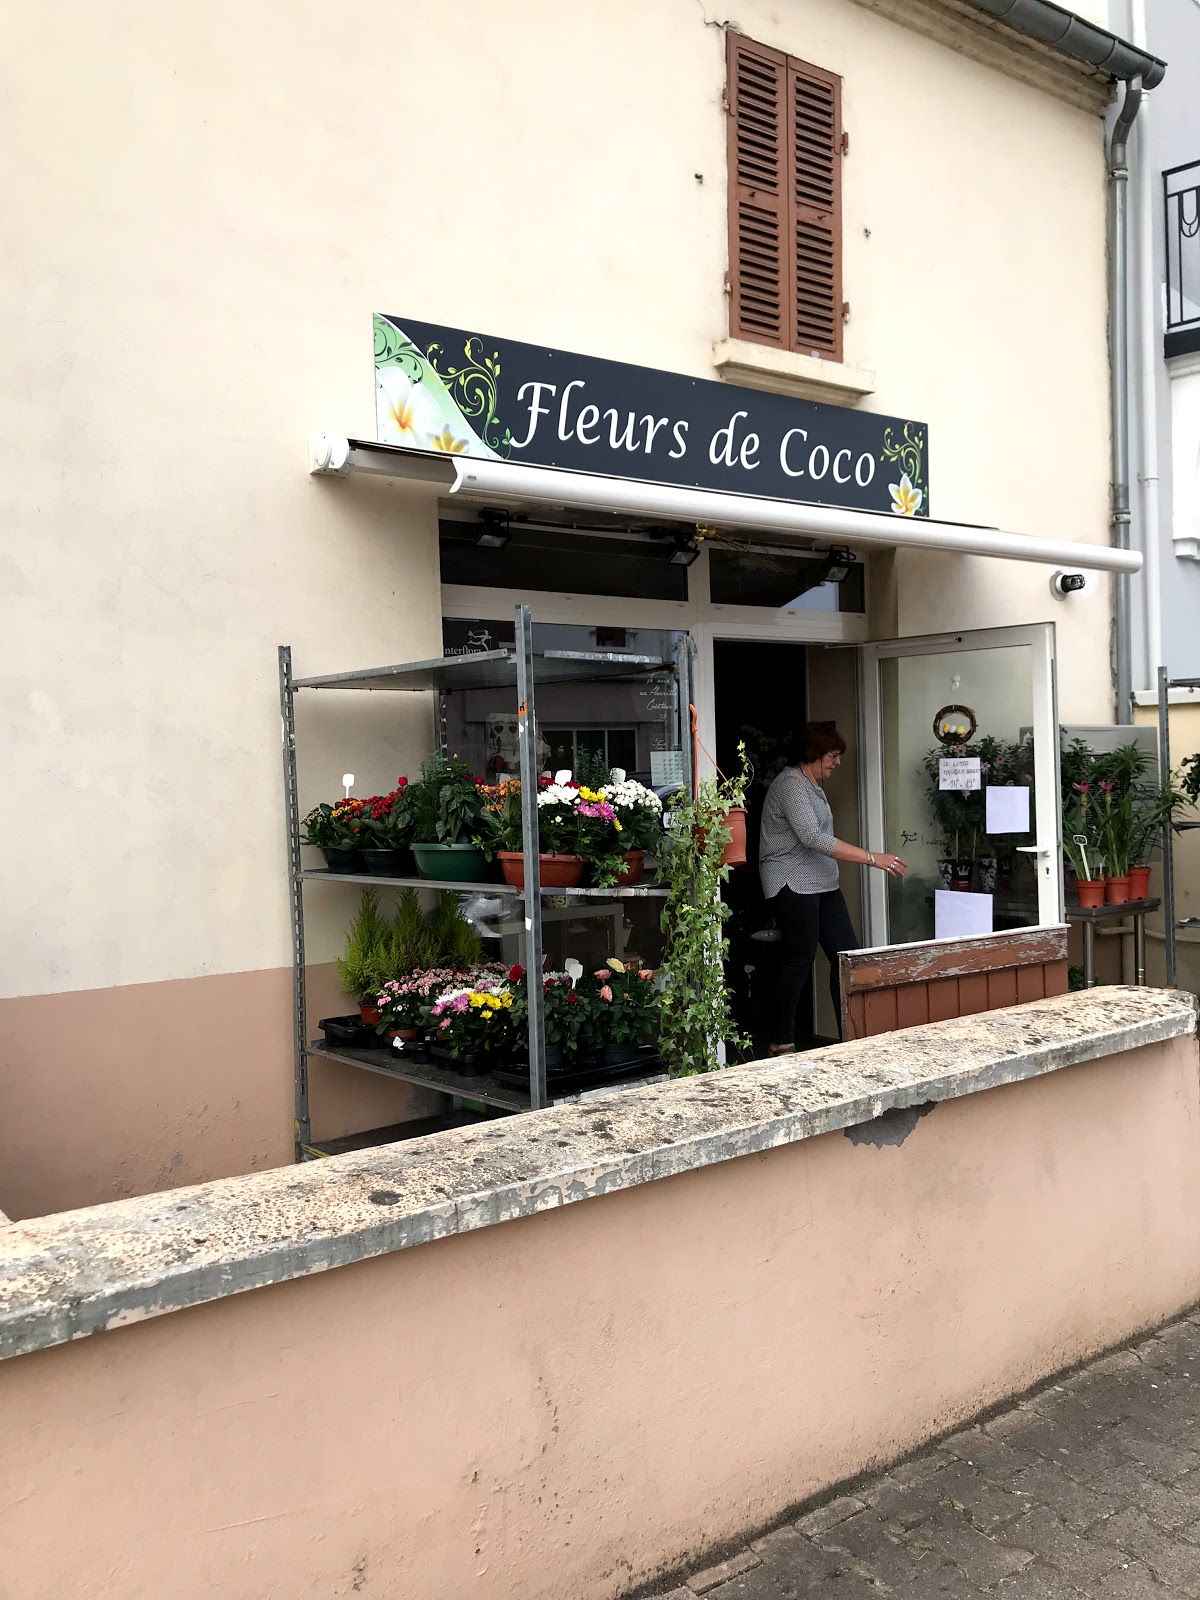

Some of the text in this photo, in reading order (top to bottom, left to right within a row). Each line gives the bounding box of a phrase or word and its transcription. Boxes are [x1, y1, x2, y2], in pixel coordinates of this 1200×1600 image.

[509, 380, 876, 487] Fleurs de Coco
[444, 644, 482, 656] nterflora
